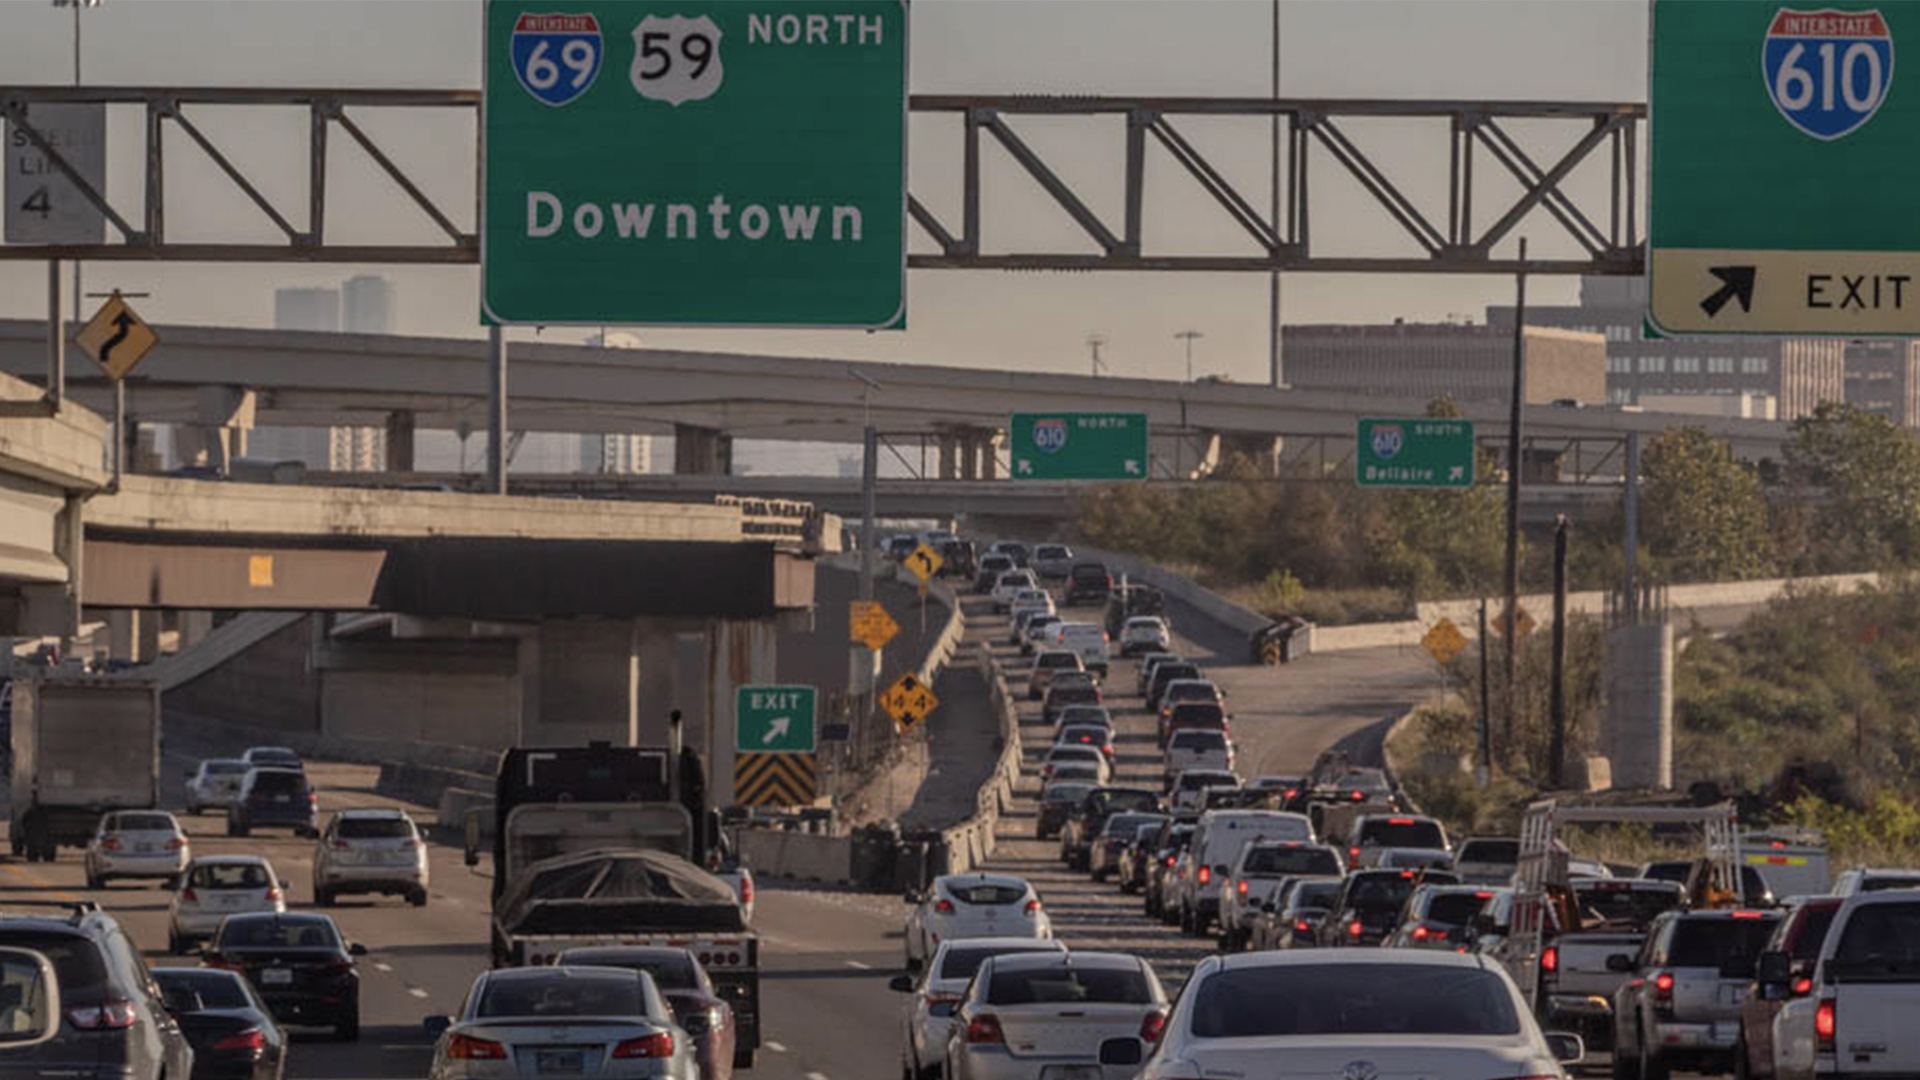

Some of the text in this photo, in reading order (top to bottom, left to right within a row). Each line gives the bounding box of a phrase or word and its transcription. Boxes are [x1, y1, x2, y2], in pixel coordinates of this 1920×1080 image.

[525, 18, 588, 30] INTERSTATE
[748, 14, 882, 44] NORTH
[1784, 17, 1873, 34] INTERSTATE
[526, 40, 595, 89] 69
[640, 32, 713, 80] 59
[1775, 42, 1882, 112] 610
[13, 128, 96, 147] SEED
[527, 191, 862, 240] Downtown
[1807, 275, 1911, 309] EXIT
[1078, 417, 1126, 428] NORTH
[1415, 424, 1462, 435] SOUTH
[1035, 427, 1065, 447] 610
[1373, 432, 1403, 452] 610
[1366, 466, 1433, 479] Bellaire
[751, 692, 799, 709] EXIT
